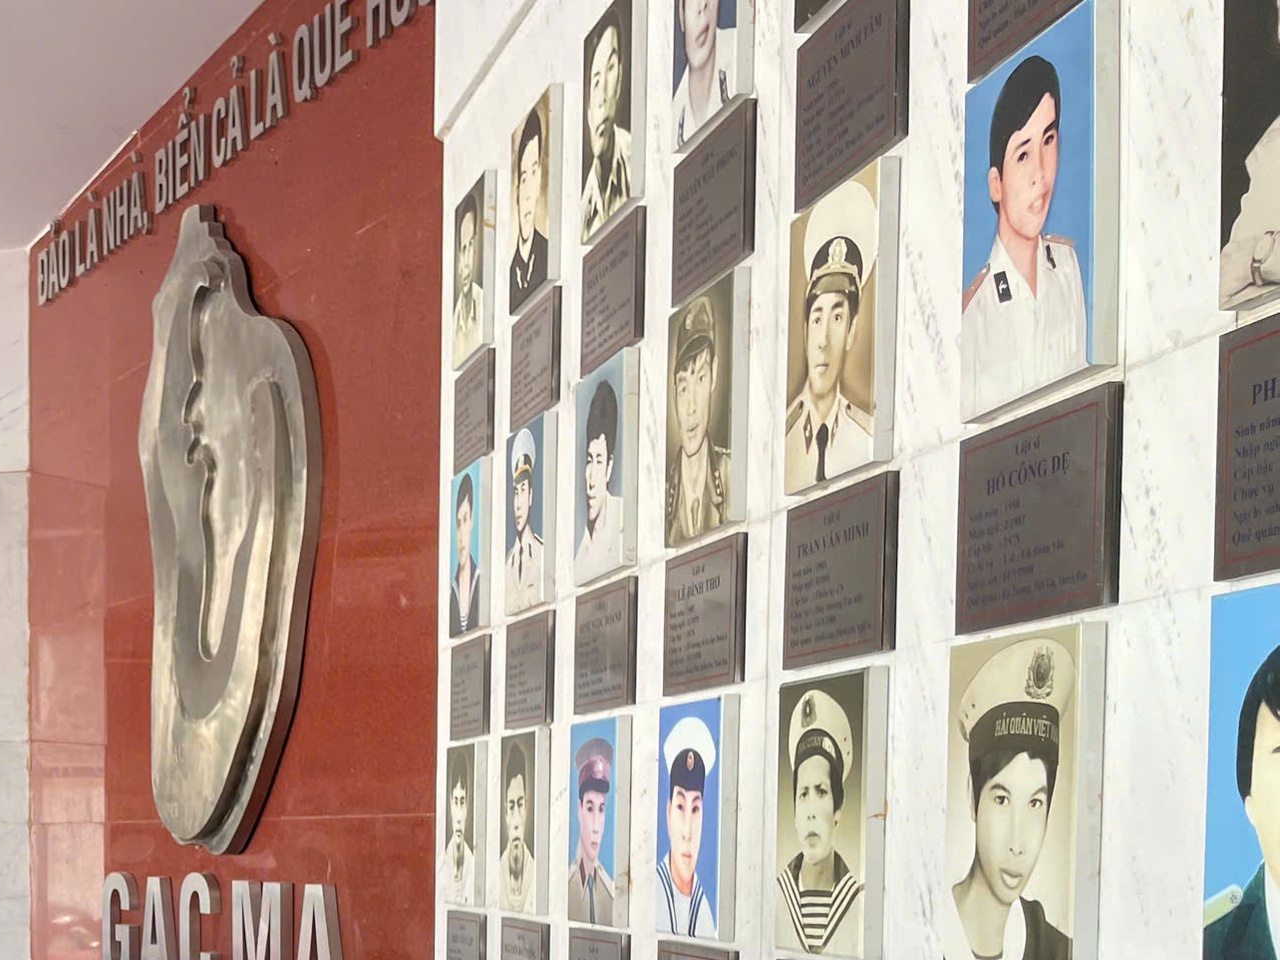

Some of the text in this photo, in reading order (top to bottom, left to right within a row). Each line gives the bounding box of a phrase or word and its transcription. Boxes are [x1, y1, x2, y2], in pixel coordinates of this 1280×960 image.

[38, 219, 71, 306] ĐẢO
[74, 190, 99, 277] LÀ
[102, 151, 152, 256] NHÀ,
[154, 86, 211, 215] BIỂN
[212, 55, 247, 169] CẢ
[249, 32, 289, 141] LÀ
[1252, 375, 1279, 406] PH
